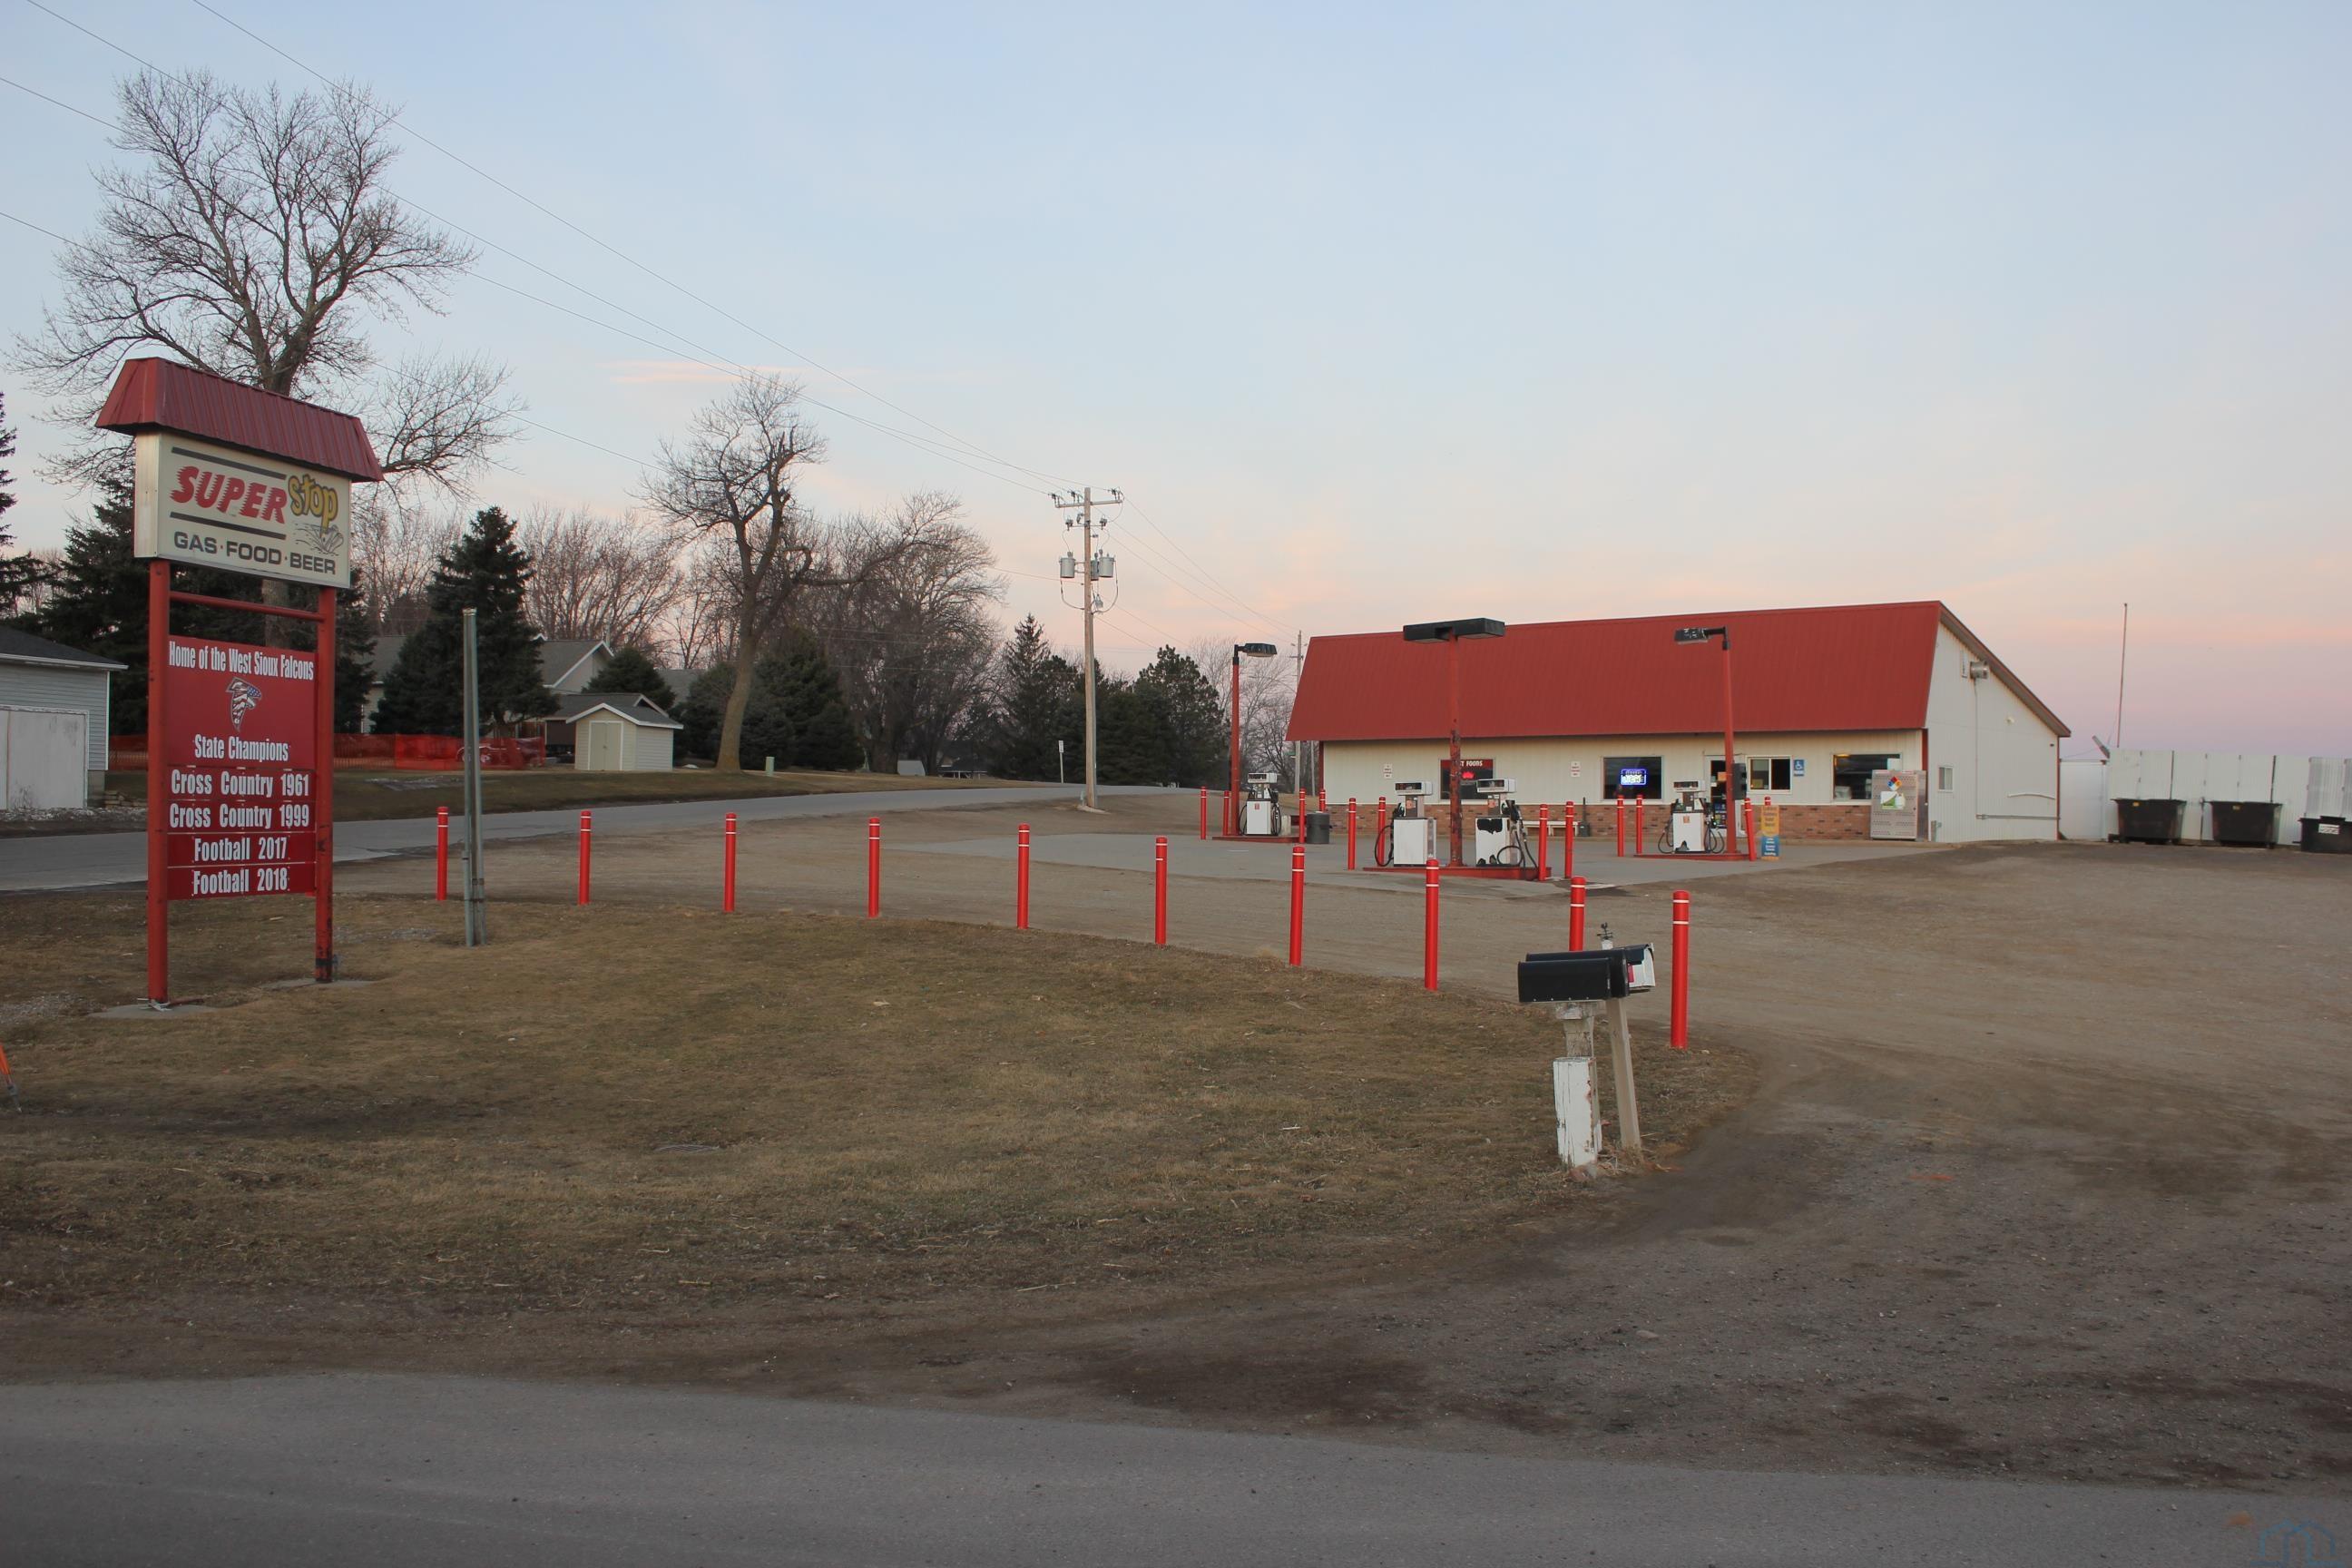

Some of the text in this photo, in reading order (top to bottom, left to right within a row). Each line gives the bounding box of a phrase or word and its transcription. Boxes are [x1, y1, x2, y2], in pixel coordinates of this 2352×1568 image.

[170, 466, 288, 524] SUPER
[174, 531, 336, 575] GAS FOOD BEER
[169, 641, 314, 681] Home of the West Sioux Falcons
[194, 733, 289, 762] State Champions
[171, 769, 309, 798] Cross Country 1961
[169, 803, 309, 829] Cross Country 1999
[194, 837, 288, 862] Football 2017
[193, 867, 288, 895] Football 2018
